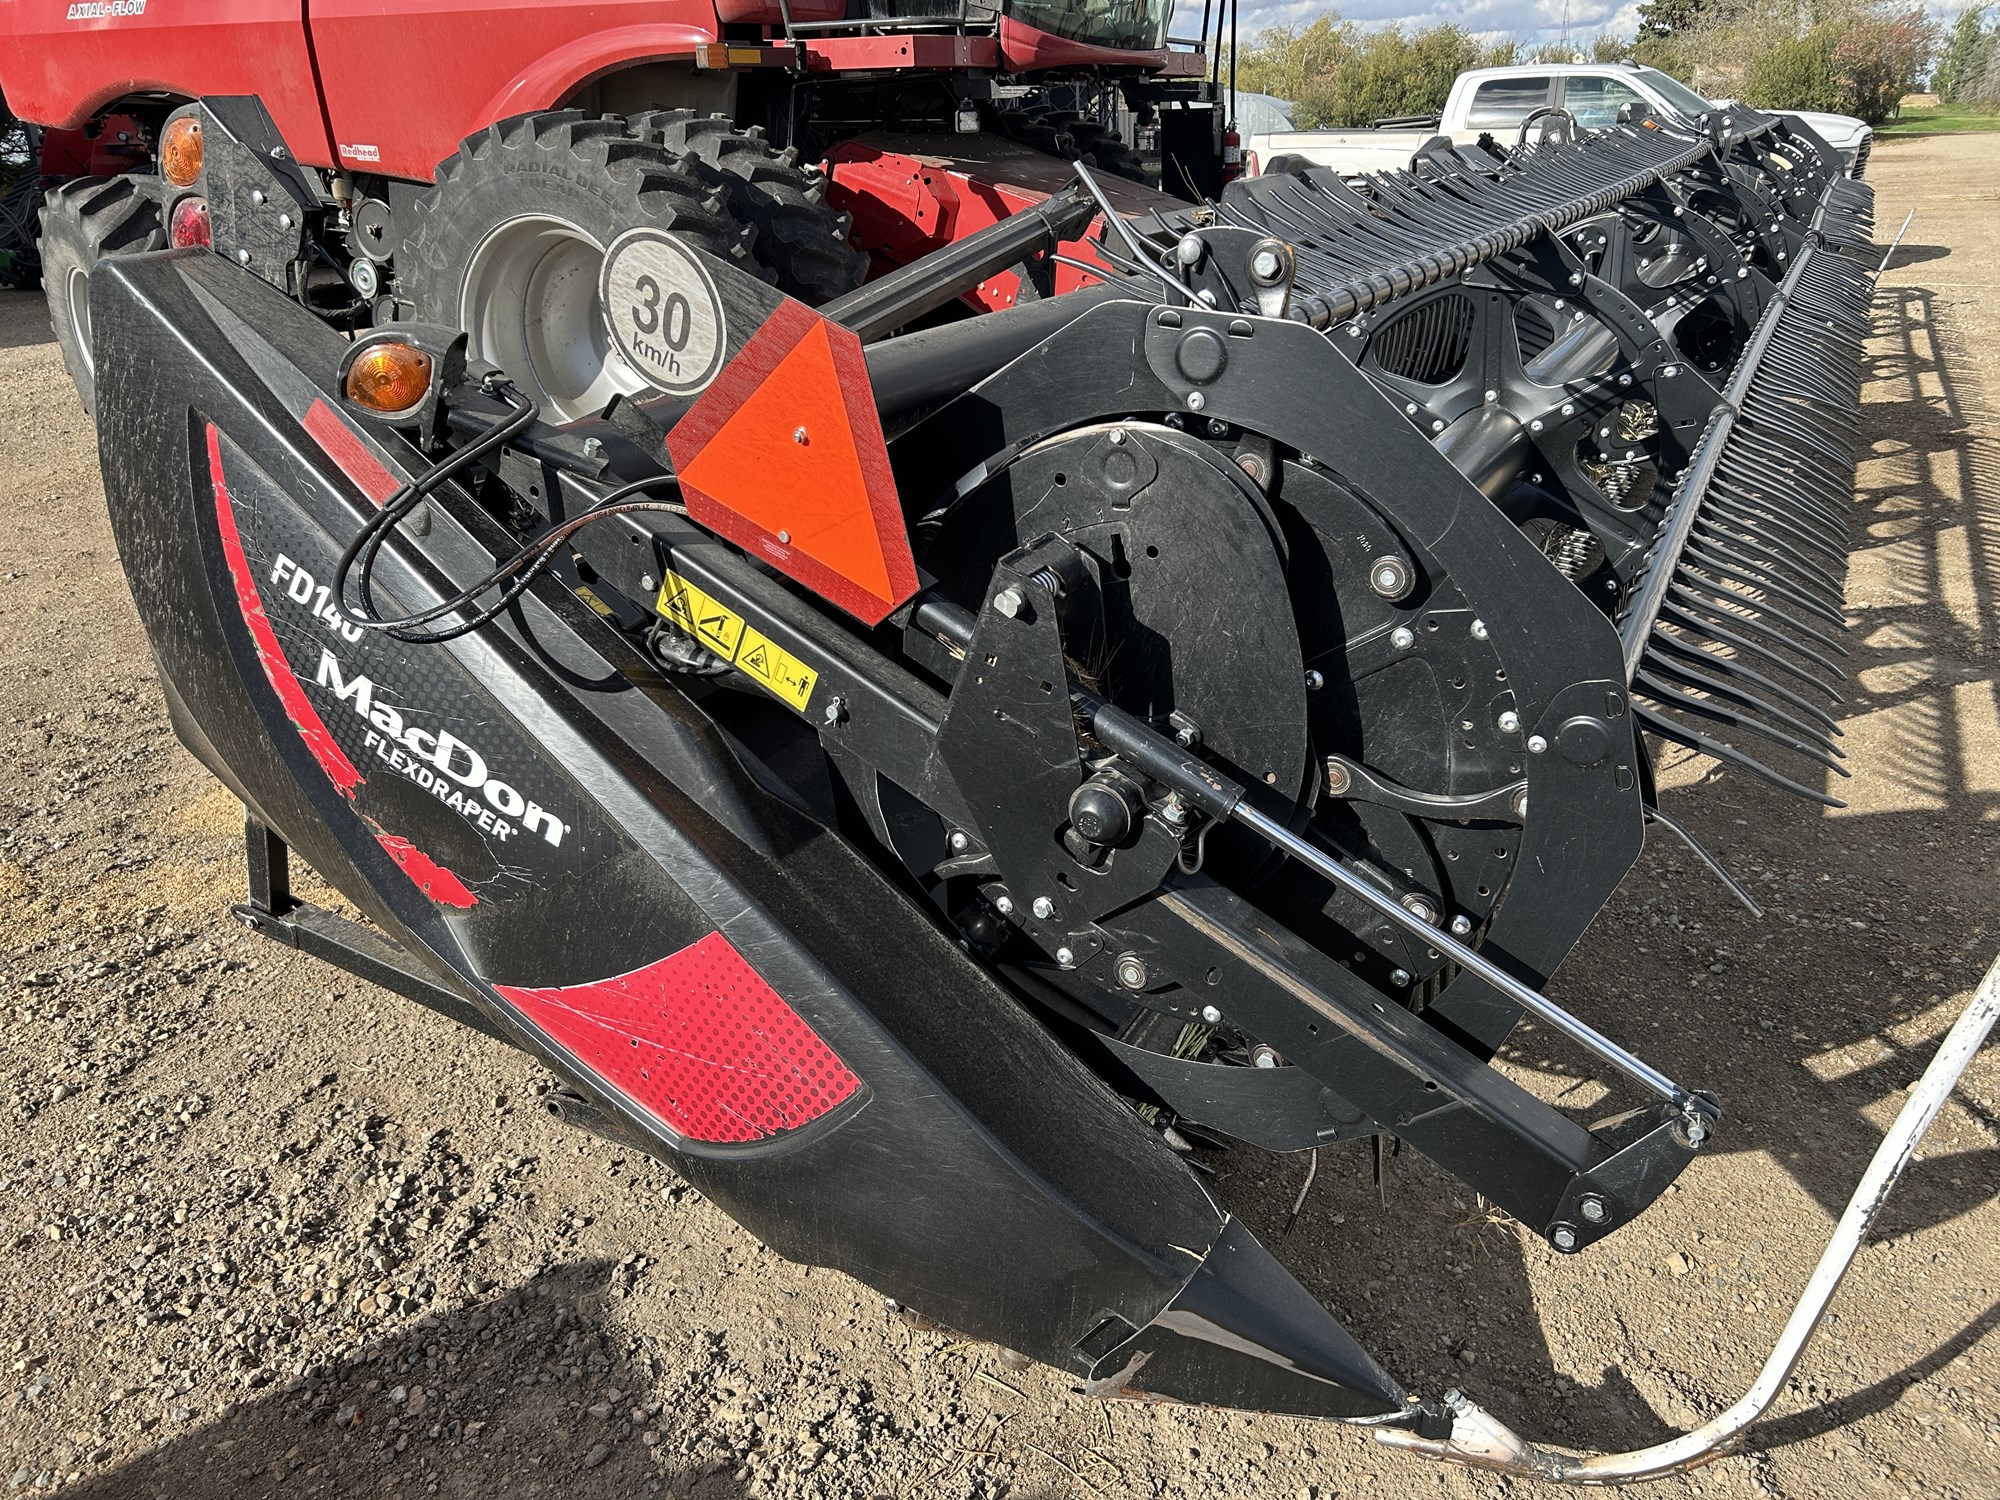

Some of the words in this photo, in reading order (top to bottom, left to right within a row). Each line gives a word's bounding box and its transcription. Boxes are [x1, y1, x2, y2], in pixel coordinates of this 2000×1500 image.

[342, 146, 378, 157] Redhead
[632, 275, 691, 352] 30
[632, 331, 681, 377] km/h
